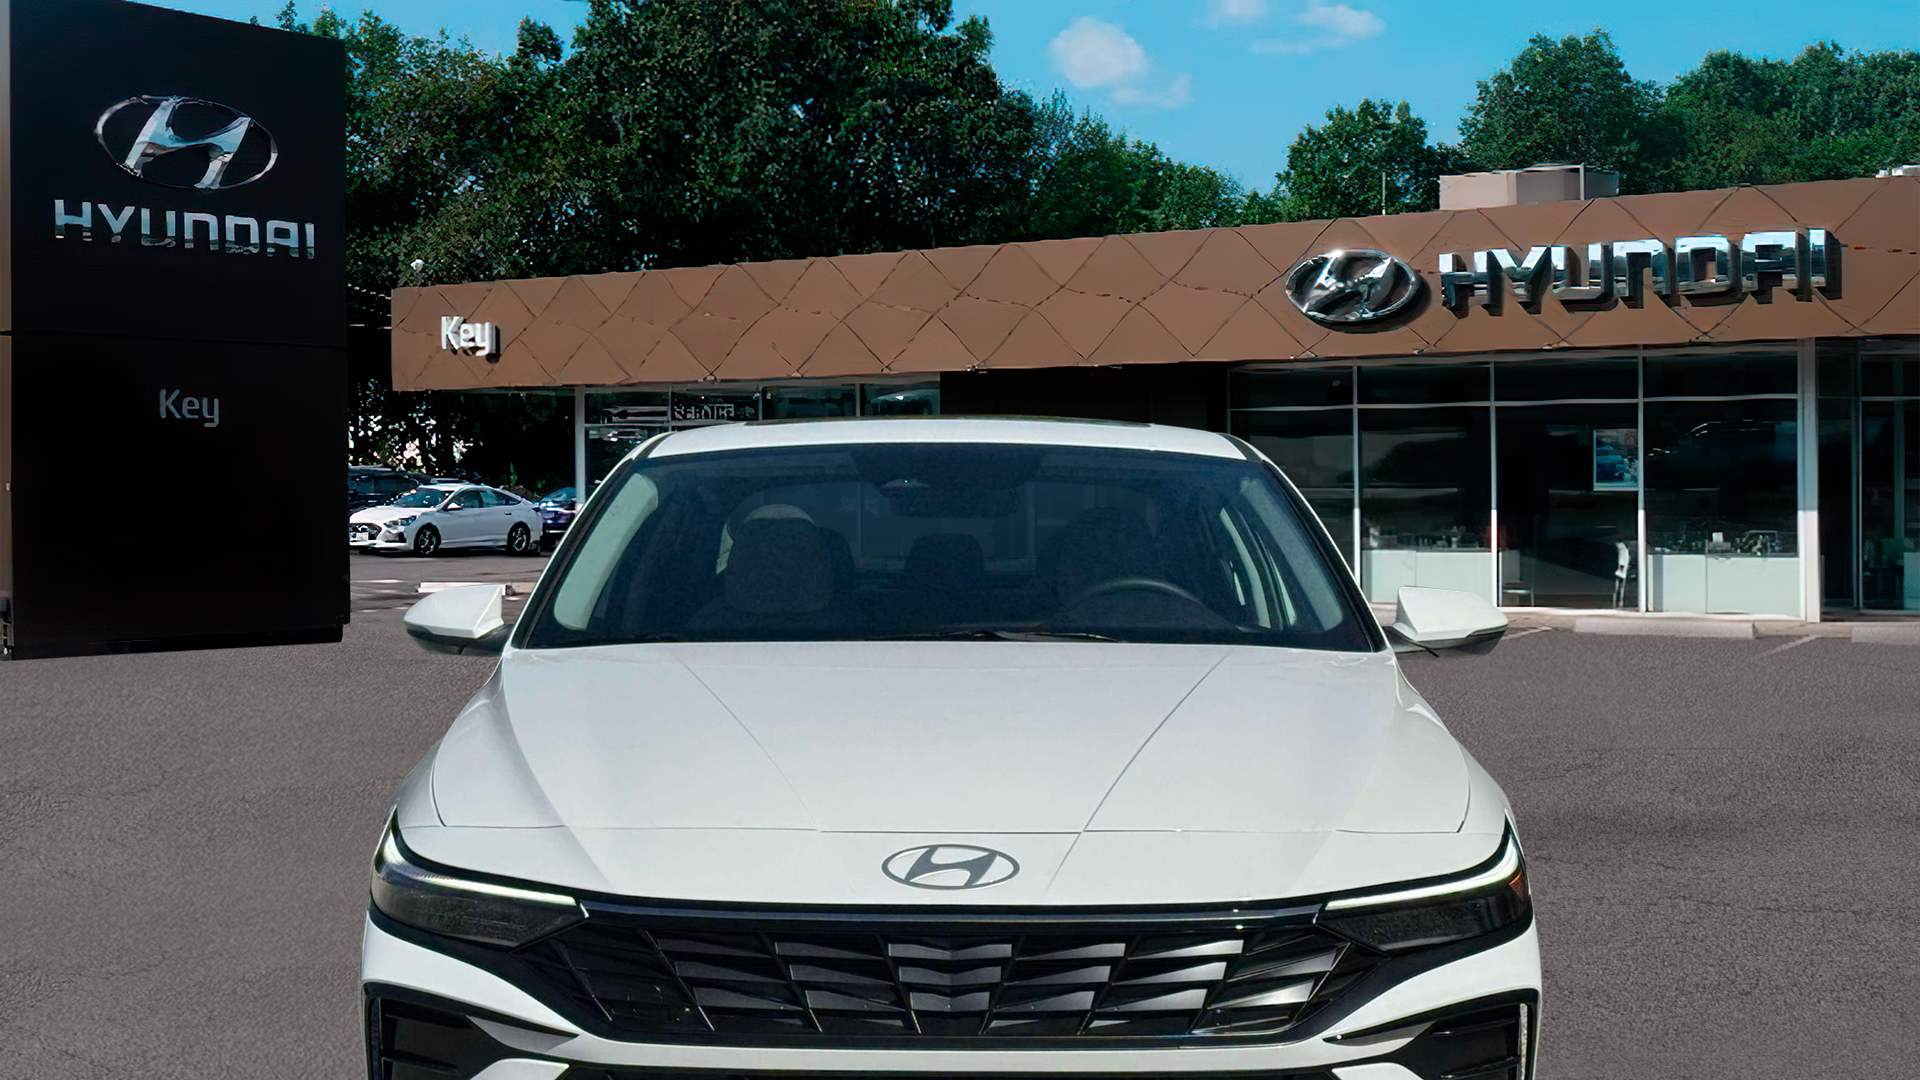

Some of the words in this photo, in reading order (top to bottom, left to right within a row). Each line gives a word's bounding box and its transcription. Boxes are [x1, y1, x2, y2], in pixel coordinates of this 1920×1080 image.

[54, 199, 315, 260] HYUNDAI
[1438, 228, 1840, 314] HYUNDAI
[441, 315, 492, 357] Key
[159, 388, 220, 428] Key
